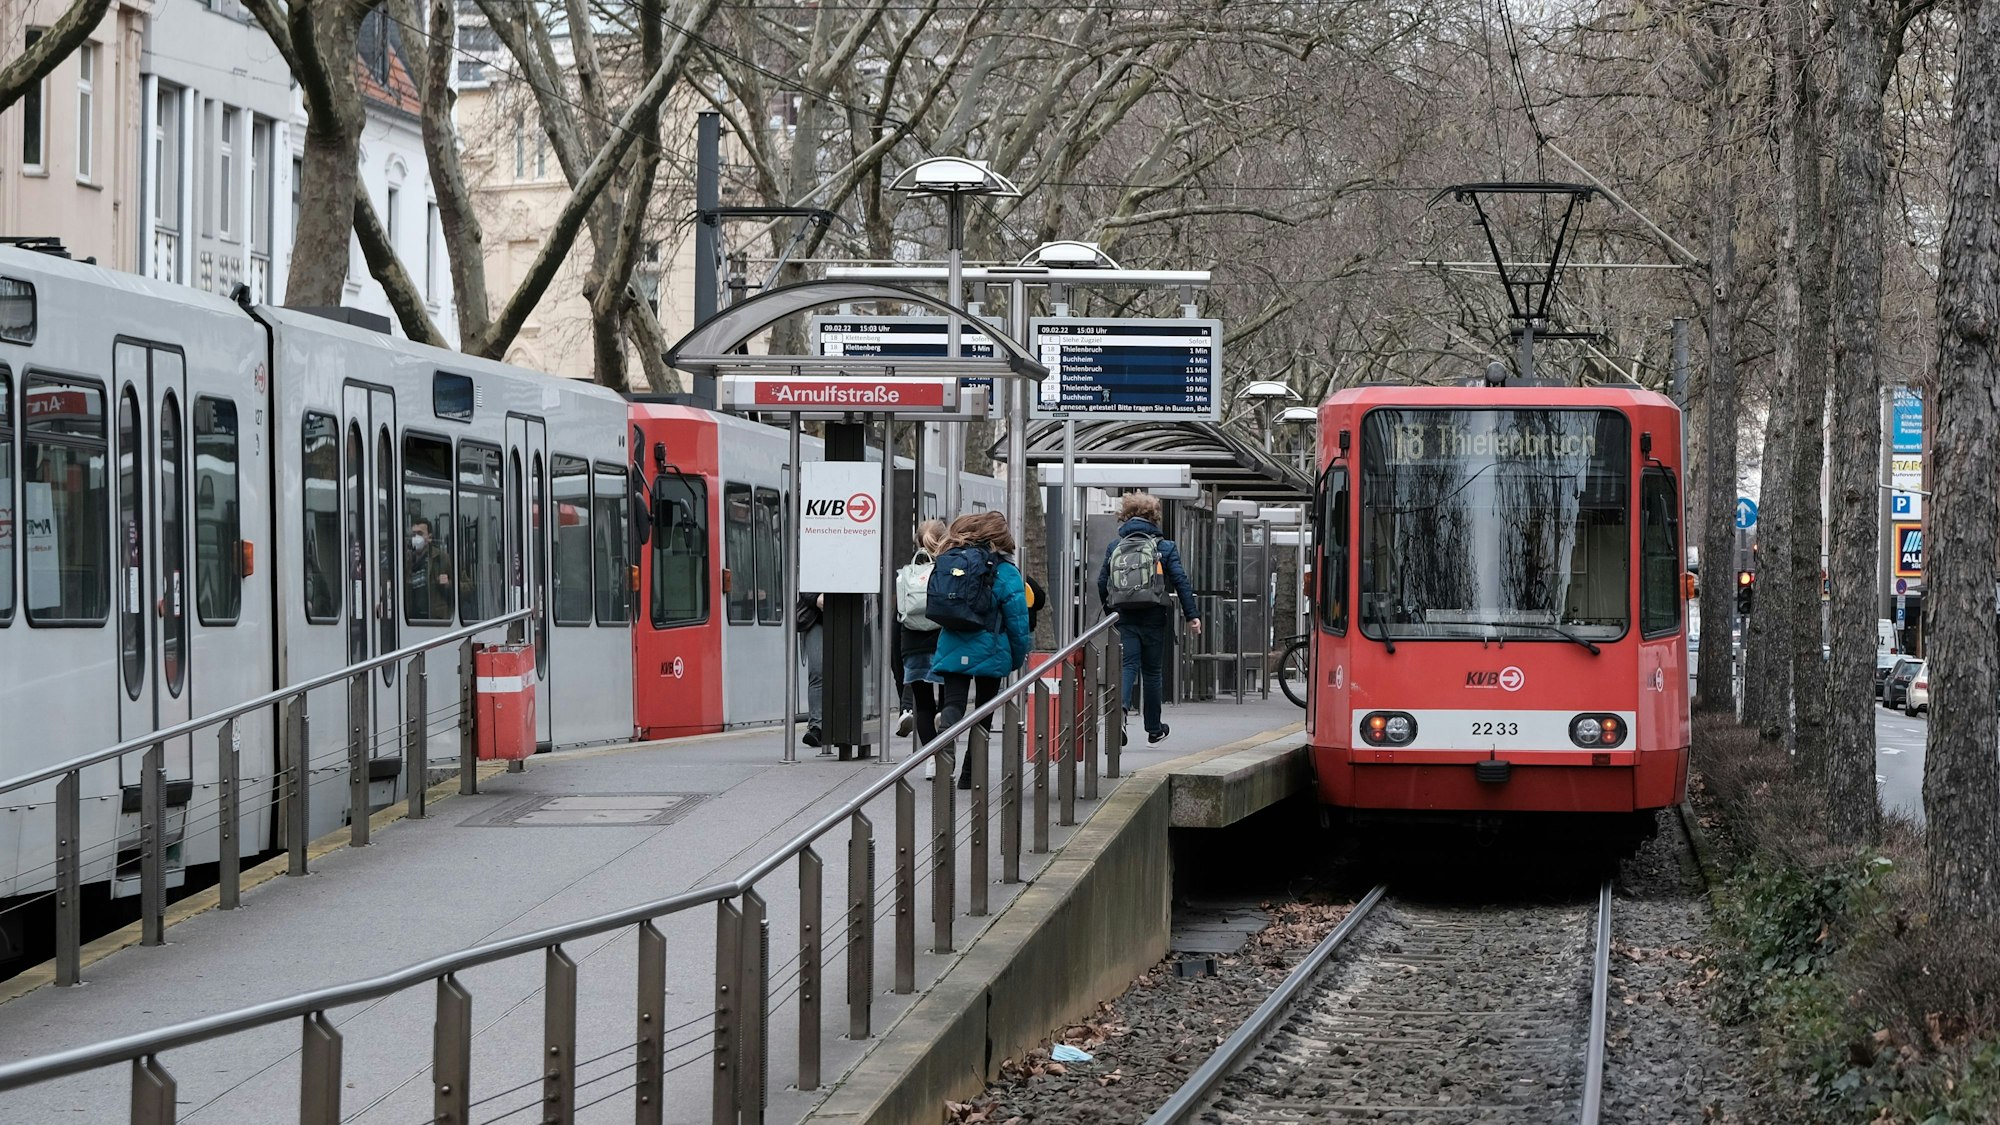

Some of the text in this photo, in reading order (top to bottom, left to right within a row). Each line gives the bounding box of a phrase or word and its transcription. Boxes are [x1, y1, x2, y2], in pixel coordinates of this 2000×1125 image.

[845, 344, 881, 352] Klettenberg
[777, 385, 900, 403] Arnulfstraße
[1395, 422, 1596, 460] 18 Thielenbruch
[805, 499, 846, 516] KVB
[843, 527, 877, 536] bewegen
[1466, 671, 1499, 686] KVB
[1472, 722, 1518, 736] 2233
